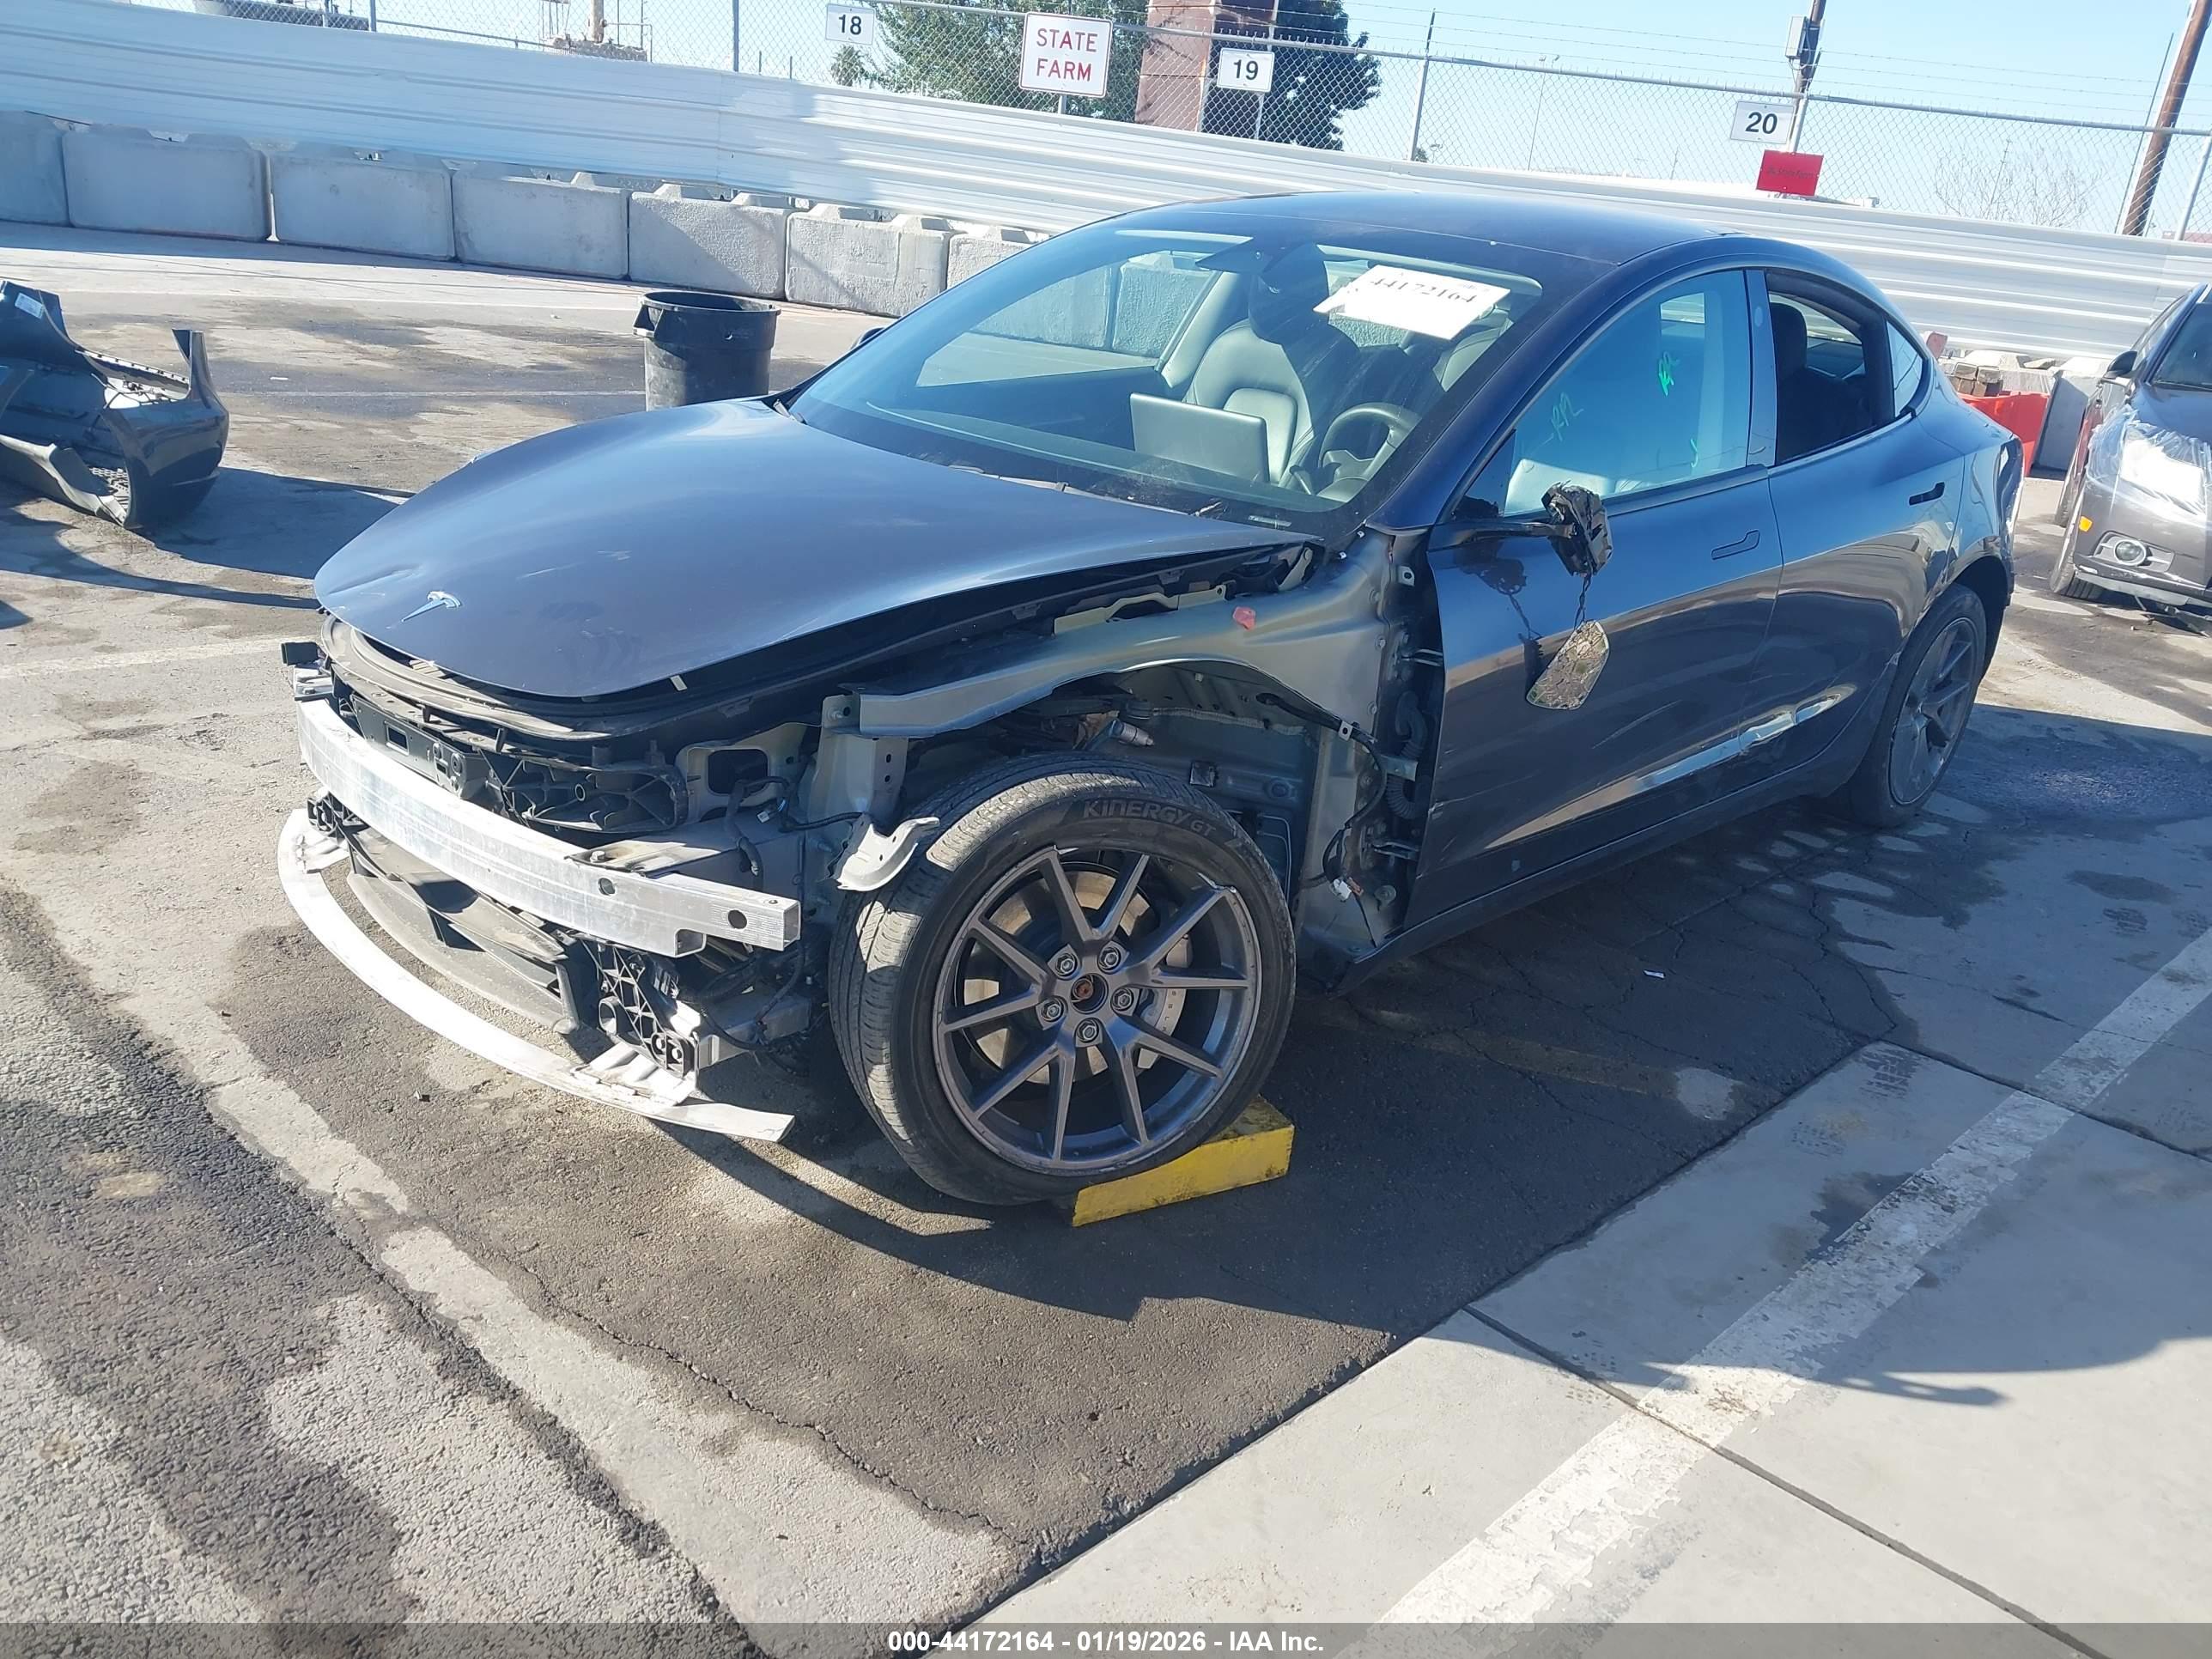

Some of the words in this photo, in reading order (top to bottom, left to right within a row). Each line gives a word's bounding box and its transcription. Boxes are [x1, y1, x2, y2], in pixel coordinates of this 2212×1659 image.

[838, 14, 862, 35] 18
[1036, 27, 1098, 52] STATE
[1036, 58, 1092, 82] FARM
[1233, 59, 1259, 81] 19
[1745, 112, 1778, 134] 20
[1190, 819, 1217, 836] GT
